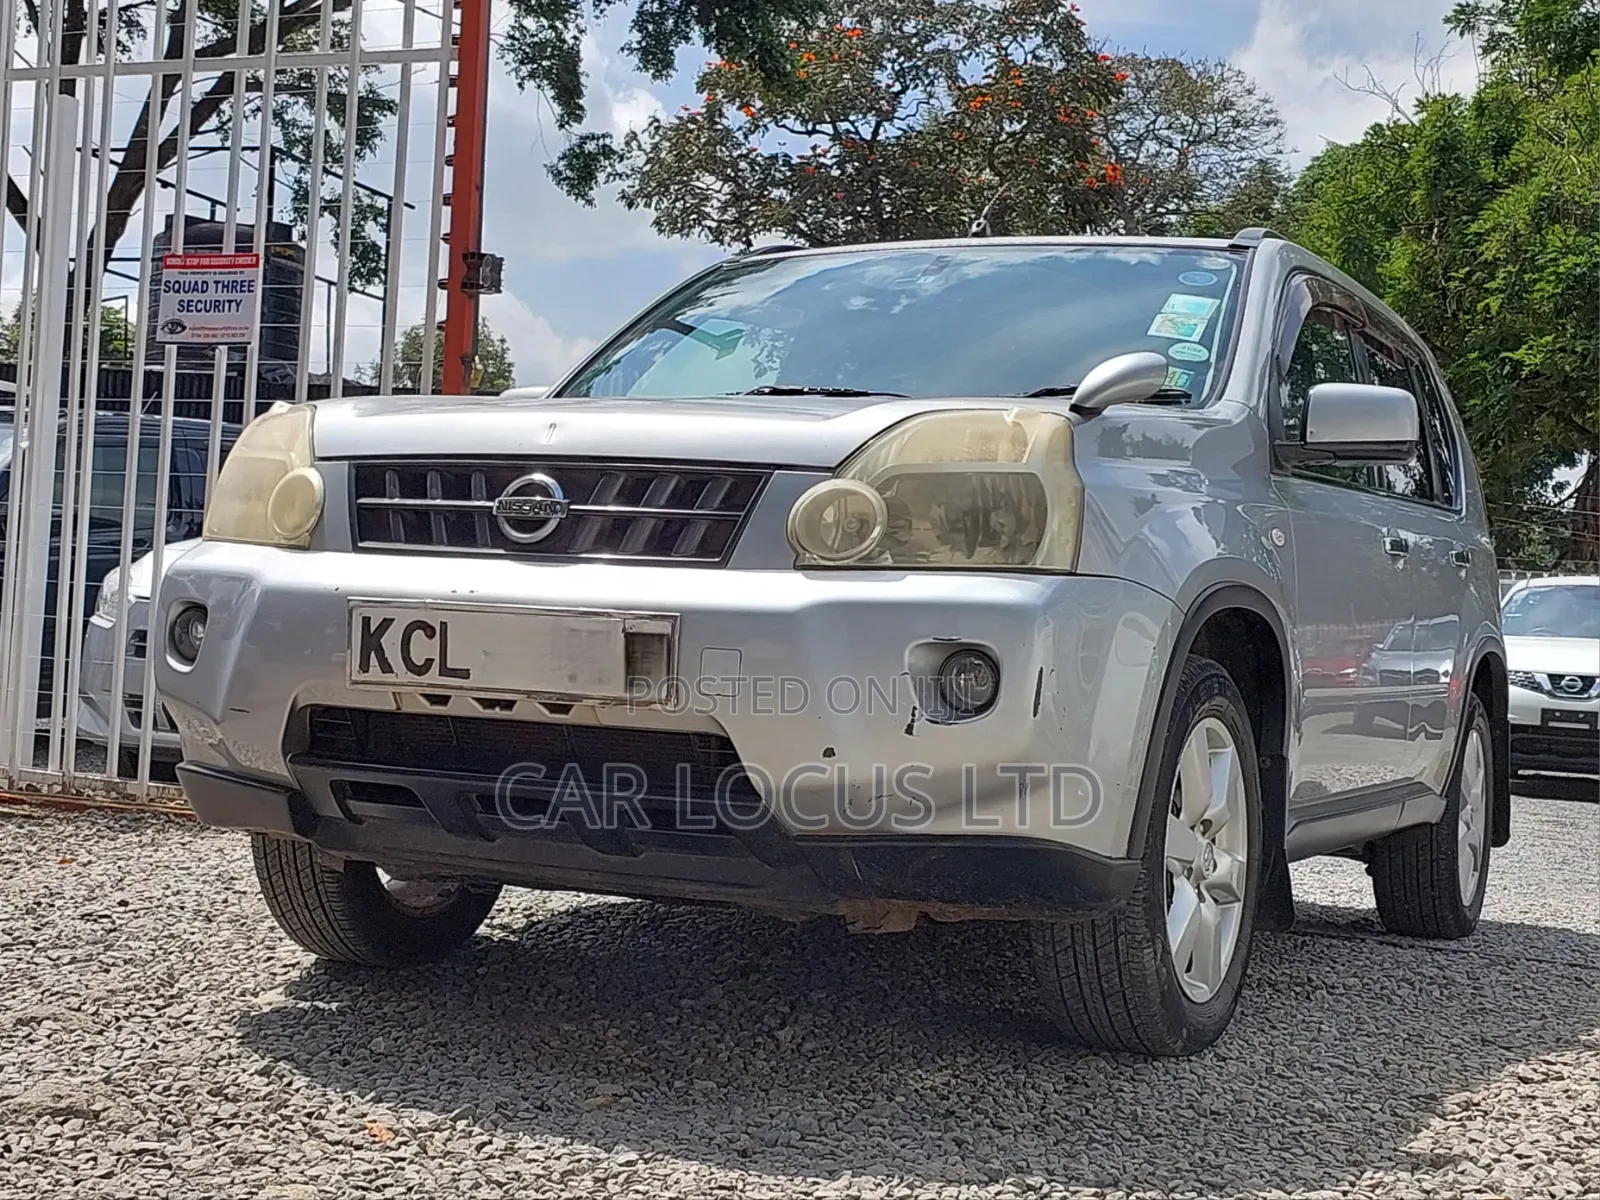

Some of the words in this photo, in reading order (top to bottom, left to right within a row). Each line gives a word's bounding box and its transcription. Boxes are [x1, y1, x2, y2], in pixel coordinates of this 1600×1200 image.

[163, 279, 209, 295] SQUAD
[213, 279, 255, 294] THREE
[176, 298, 243, 313] SECURITY
[497, 500, 555, 516] NISSAN
[358, 615, 471, 680] KCL
